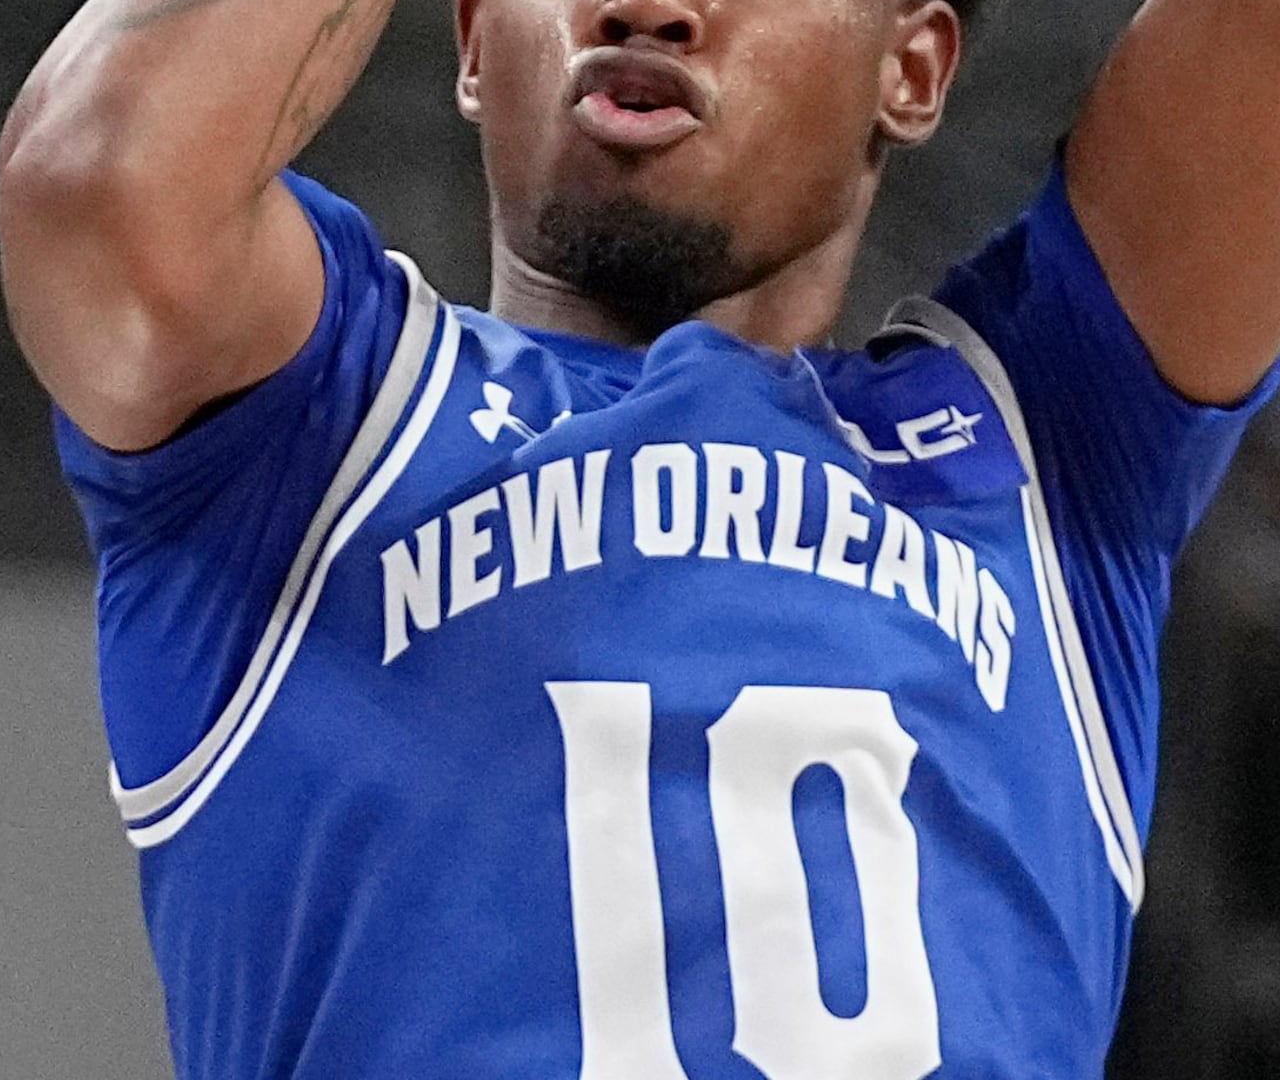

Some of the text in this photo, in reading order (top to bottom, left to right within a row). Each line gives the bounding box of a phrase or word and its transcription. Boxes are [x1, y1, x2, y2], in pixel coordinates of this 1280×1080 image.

[380, 442, 1016, 713] NEW ORLEANS
[544, 681, 942, 1080] 10
